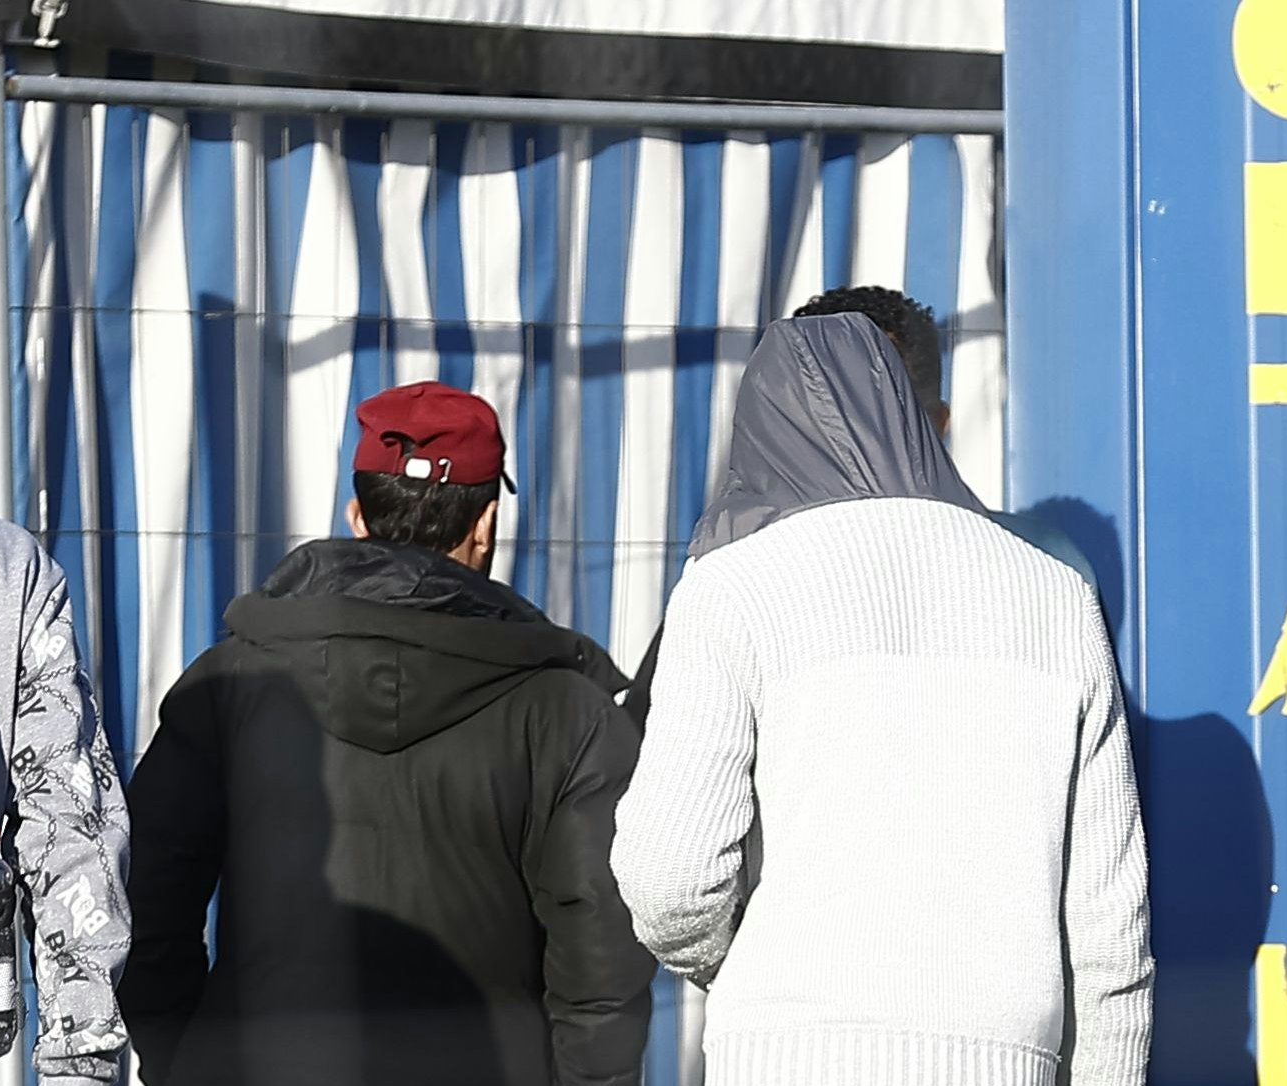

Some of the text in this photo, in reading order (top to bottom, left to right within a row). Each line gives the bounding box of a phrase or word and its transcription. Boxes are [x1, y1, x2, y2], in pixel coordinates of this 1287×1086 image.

[12, 745, 52, 796] BOY
[56, 881, 110, 937] BOY
[45, 929, 90, 983] BOY
